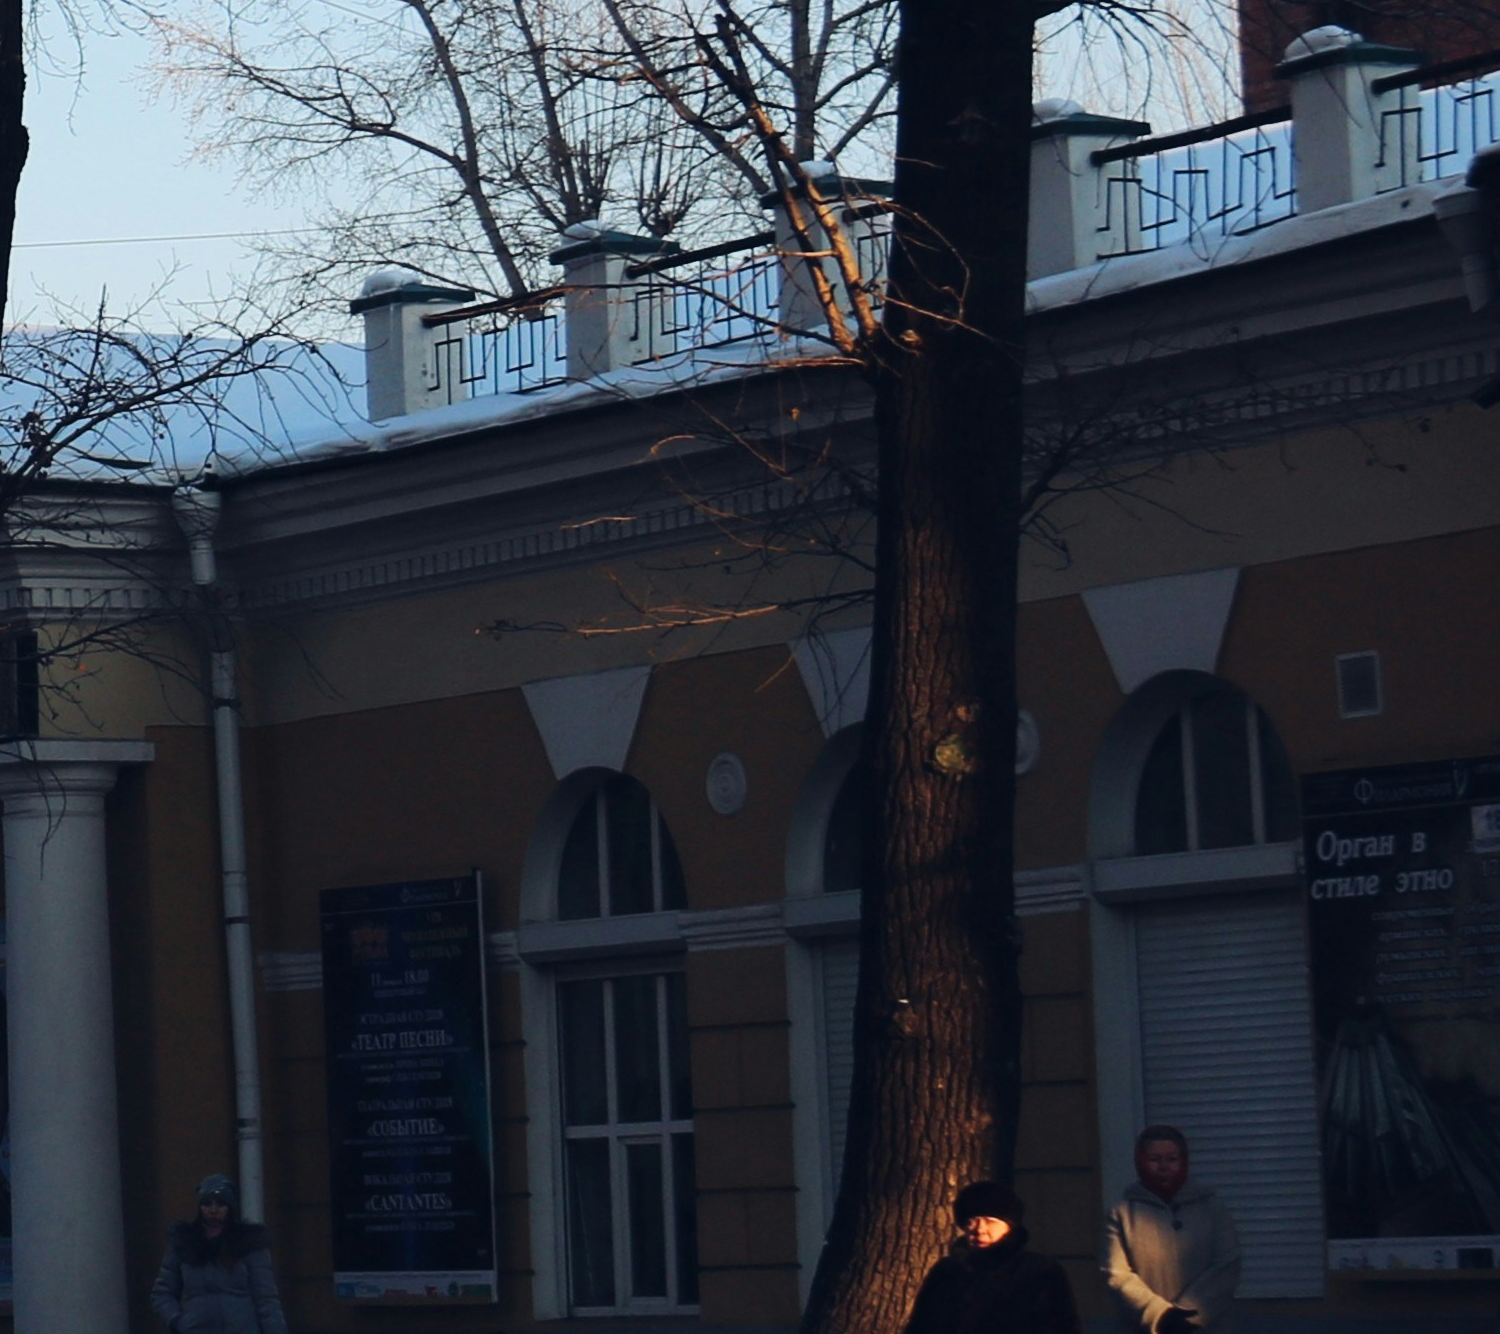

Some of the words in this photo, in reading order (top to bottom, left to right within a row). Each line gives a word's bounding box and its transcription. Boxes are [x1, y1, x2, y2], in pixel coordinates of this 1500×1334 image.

[1315, 830, 1396, 867] Орган
[1411, 831, 1428, 854] в
[1310, 873, 1381, 900] стиле
[1395, 868, 1454, 895] этно
